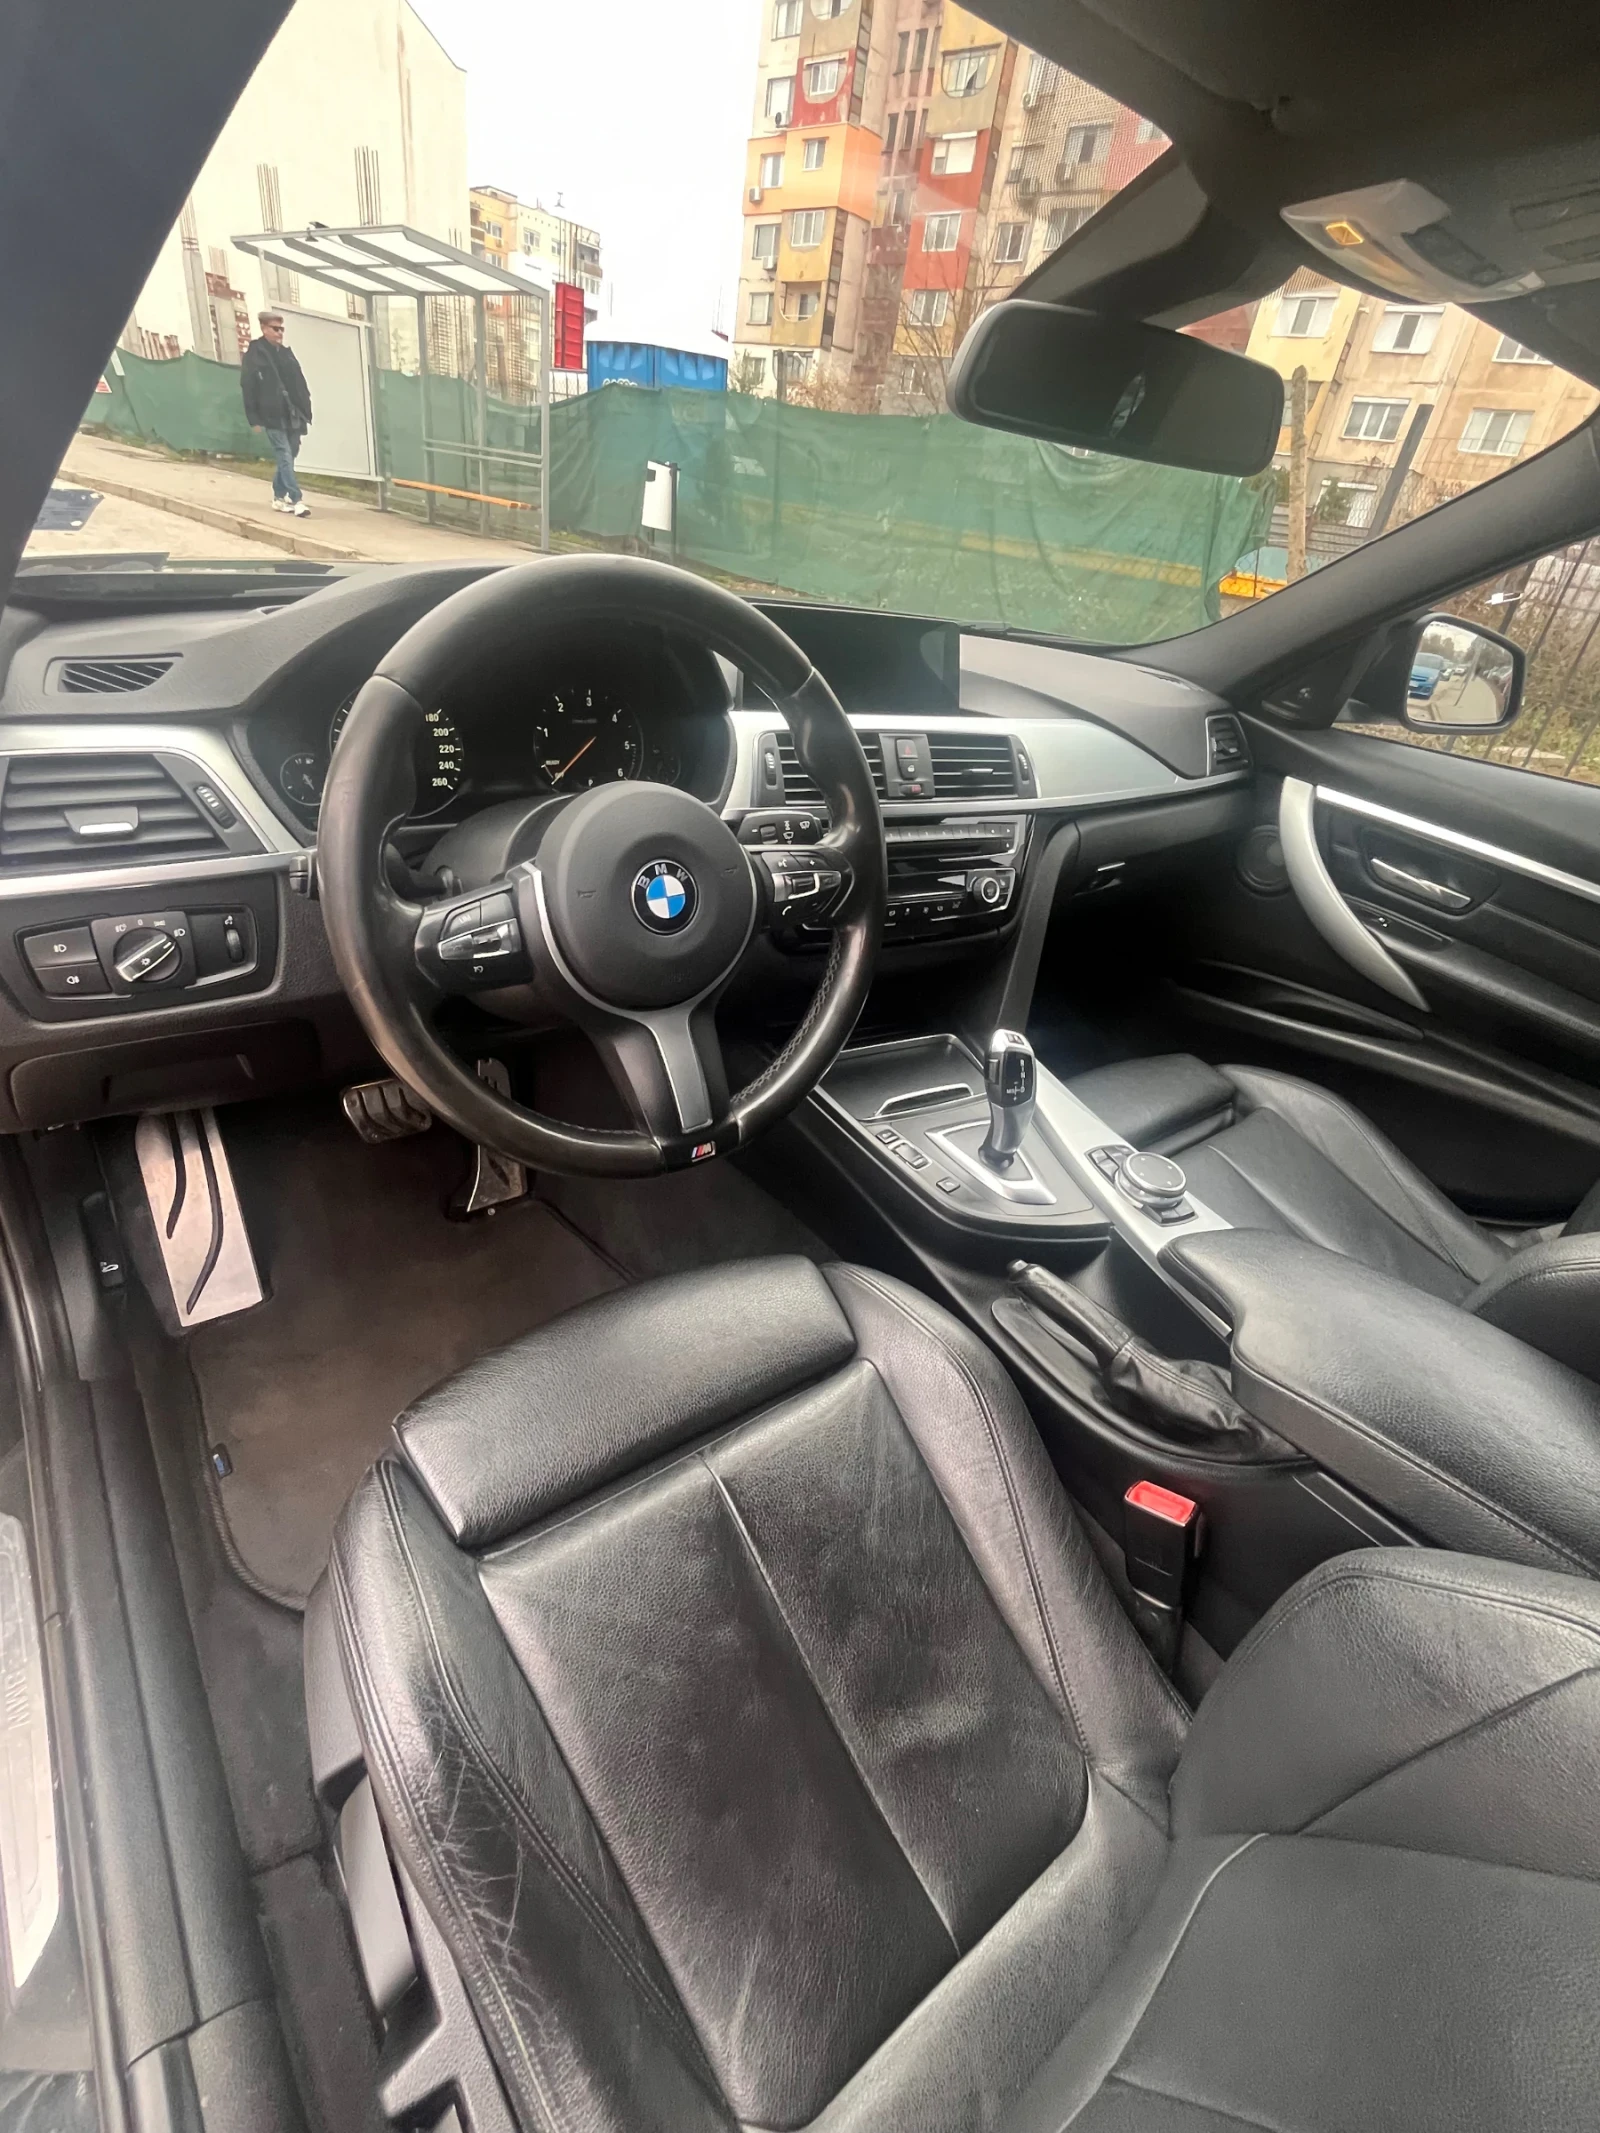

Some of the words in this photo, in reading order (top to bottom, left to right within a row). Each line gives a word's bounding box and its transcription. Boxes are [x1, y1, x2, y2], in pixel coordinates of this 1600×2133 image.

[586, 697, 592, 707] 3
[557, 702, 564, 713] 2
[425, 713, 439, 722] 180
[612, 713, 618, 723] 4
[433, 728, 449, 737] 200
[543, 727, 549, 738] 1
[439, 745, 455, 754] 220
[624, 741, 630, 750] 5
[438, 761, 455, 770] 240
[617, 768, 624, 777] 6
[432, 778, 448, 787] 260
[637, 863, 689, 889] BMW
